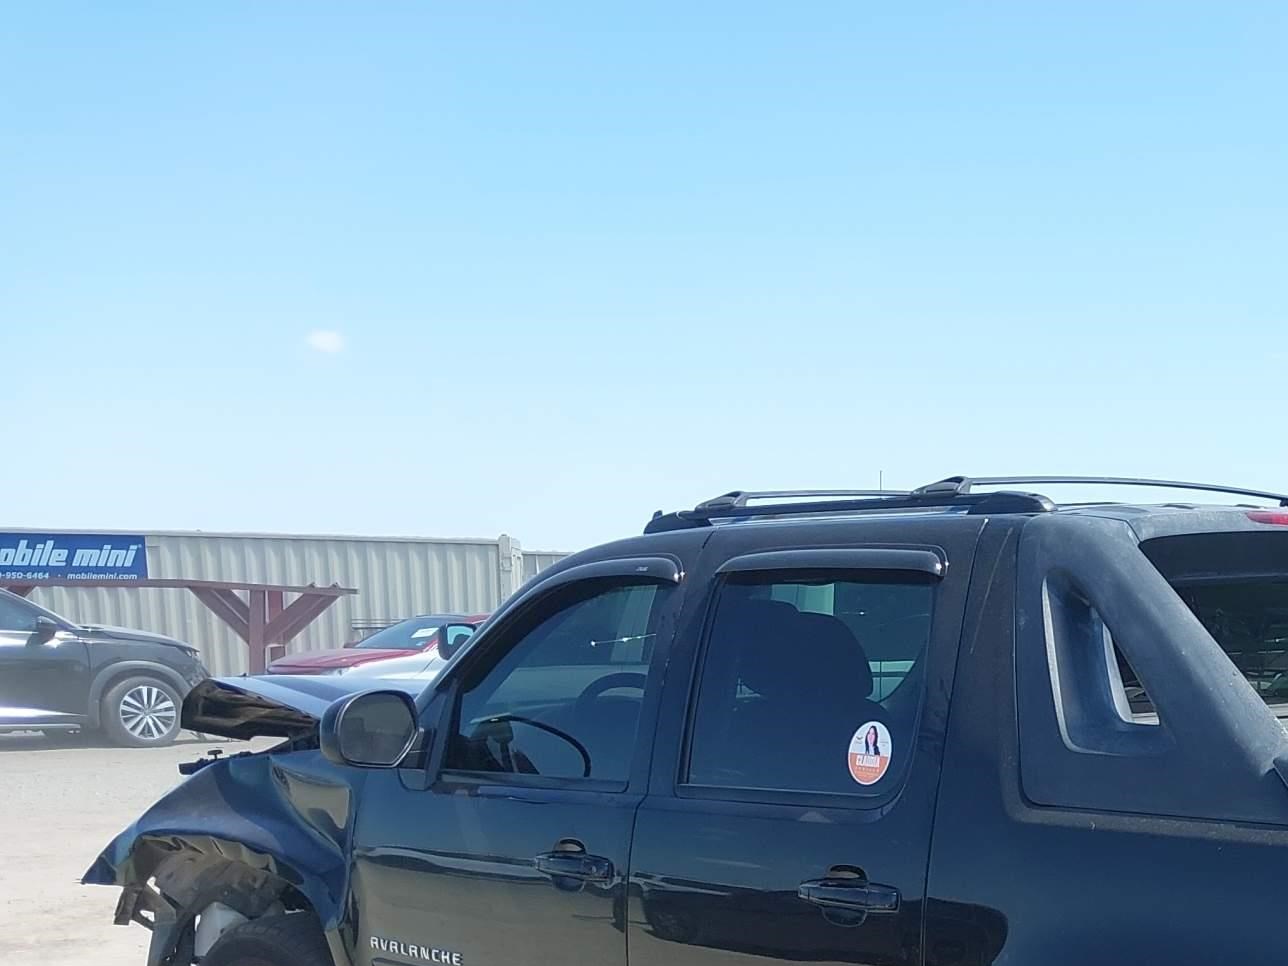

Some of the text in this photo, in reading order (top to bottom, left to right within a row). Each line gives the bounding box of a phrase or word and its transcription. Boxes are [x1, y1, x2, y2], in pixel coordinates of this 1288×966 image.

[0, 540, 138, 567] obile mini
[67, 572, 138, 580] mobilemini.com
[370, 936, 464, 966] AVALANCHE
